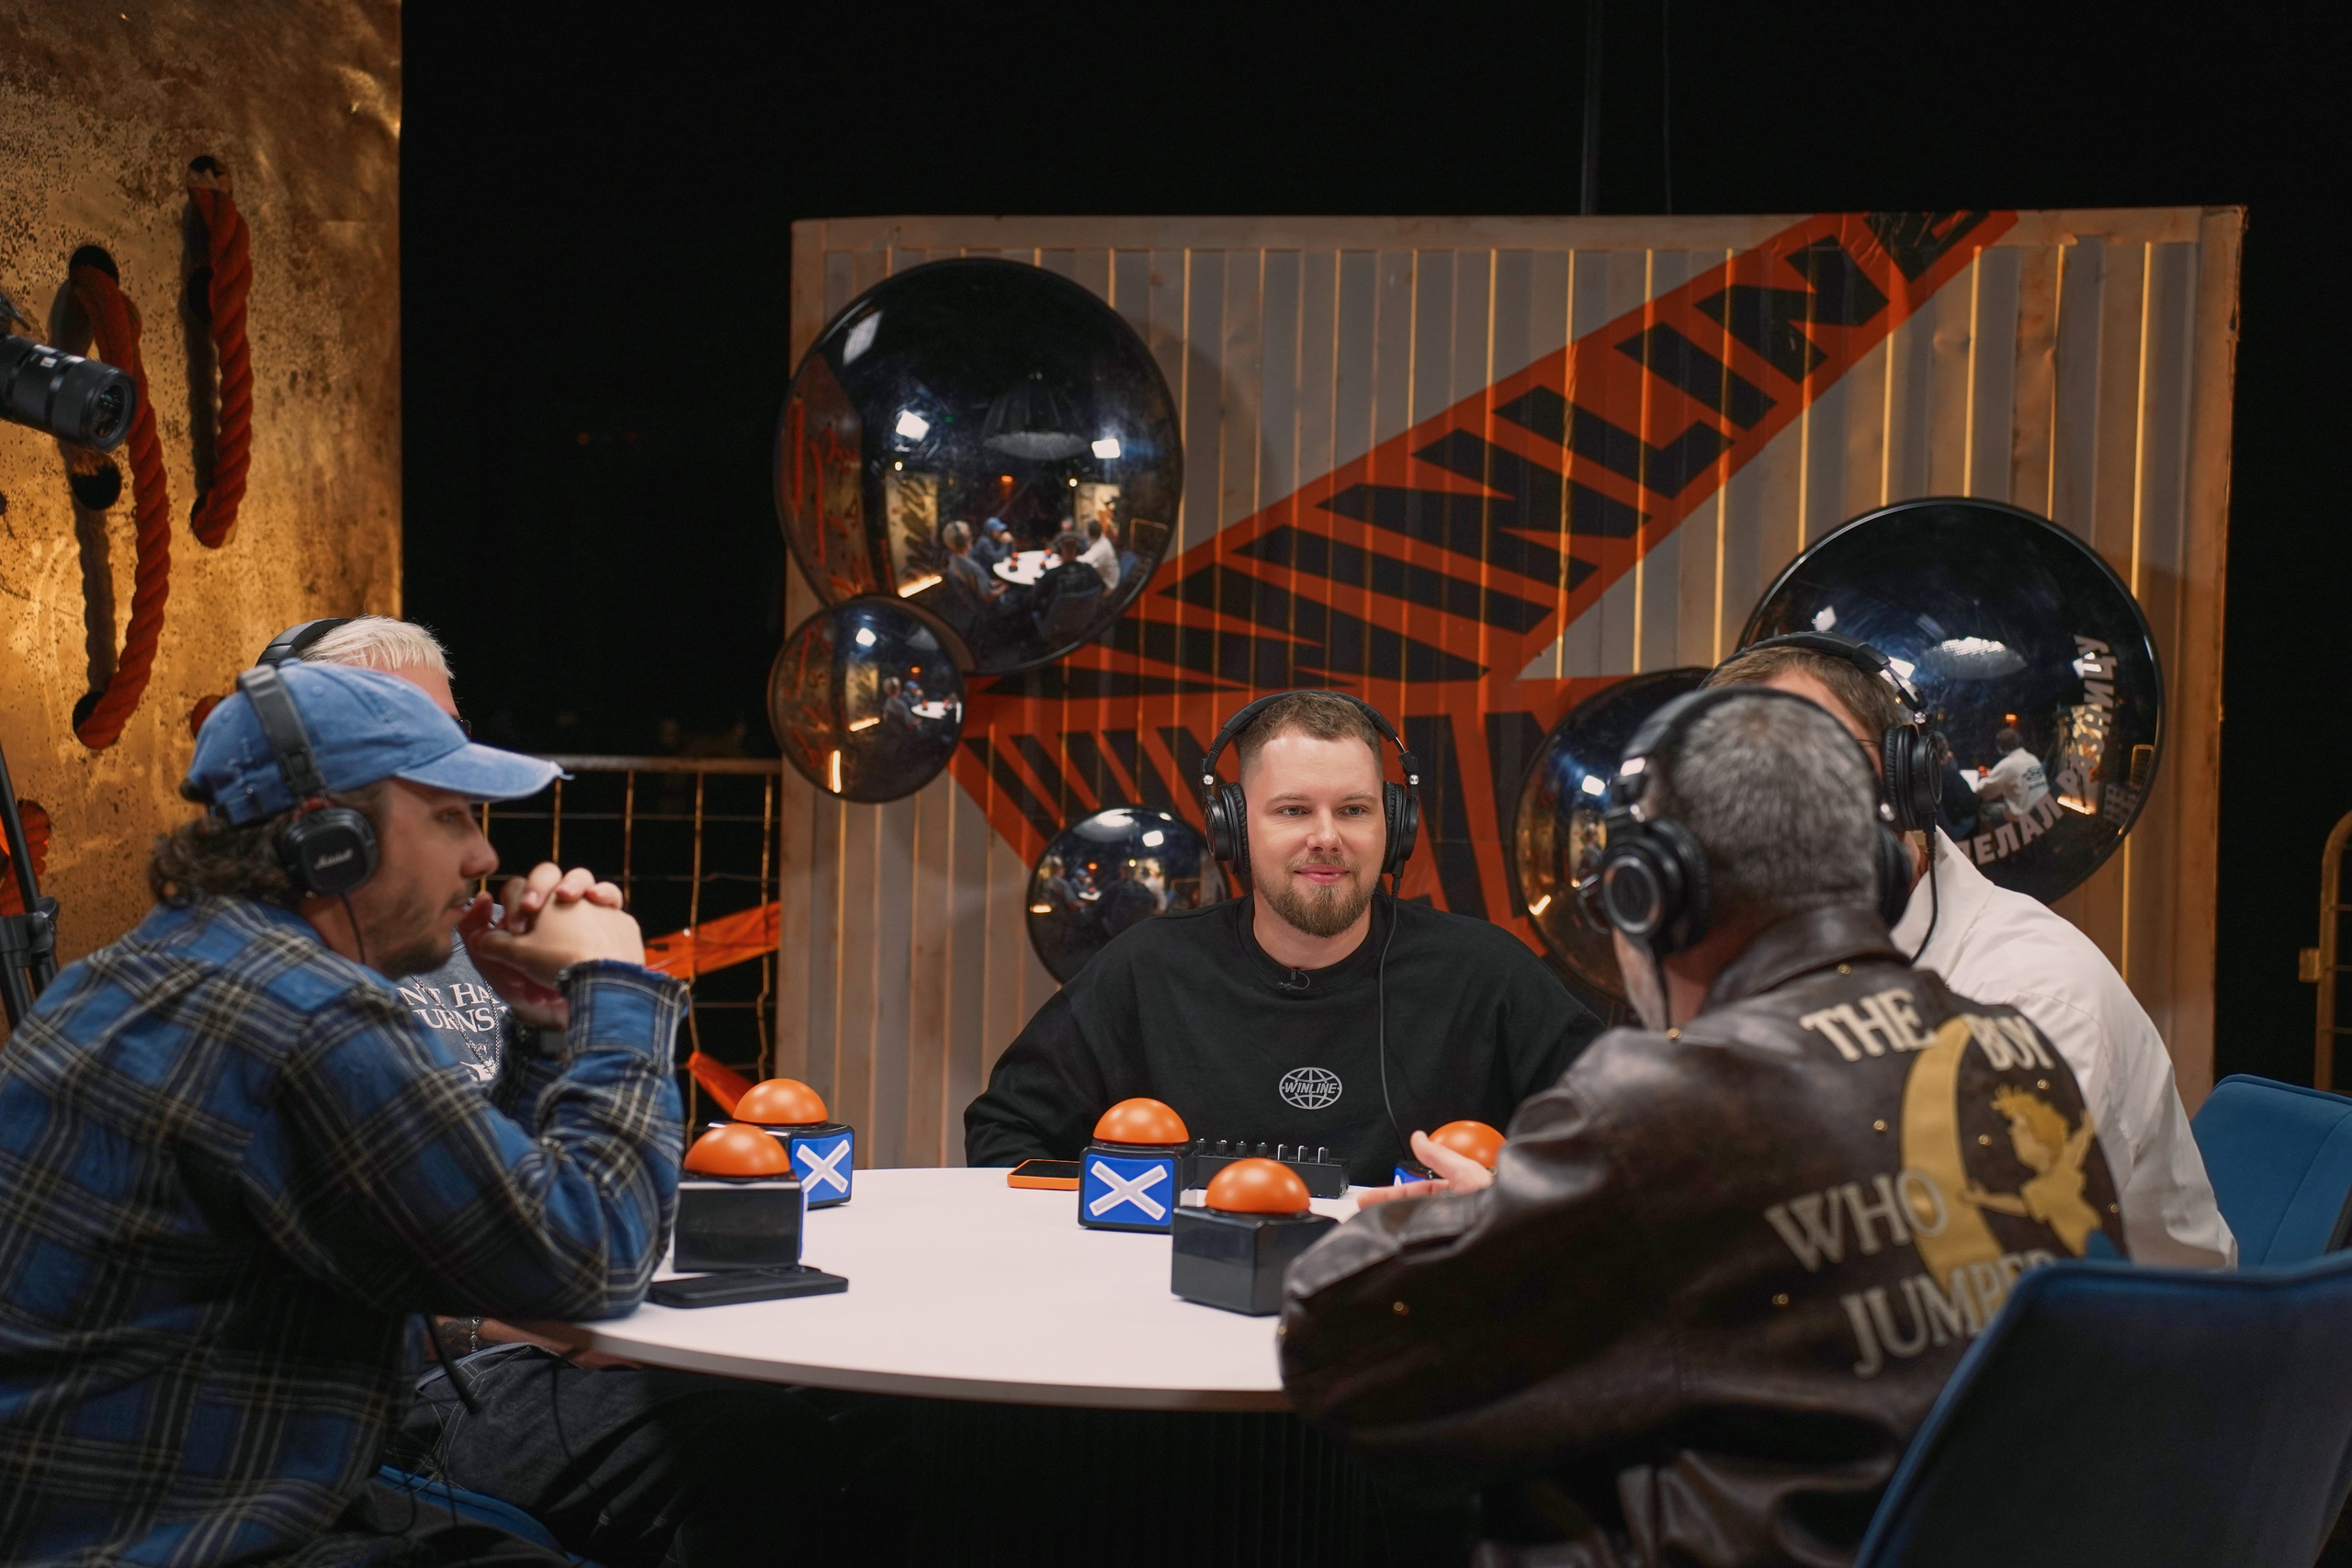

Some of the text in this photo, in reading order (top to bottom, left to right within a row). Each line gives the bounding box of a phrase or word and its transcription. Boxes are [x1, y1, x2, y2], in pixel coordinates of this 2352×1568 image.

[979, 209, 1990, 698] WINLINE
[396, 982, 501, 1008] N'T HA
[413, 1007, 495, 1032] URNS
[1798, 987, 2056, 1071] THE BOY
[1284, 1082, 1338, 1094] WINLINE
[1763, 1168, 1949, 1273] WHO
[1839, 1247, 2056, 1378] JUMP
